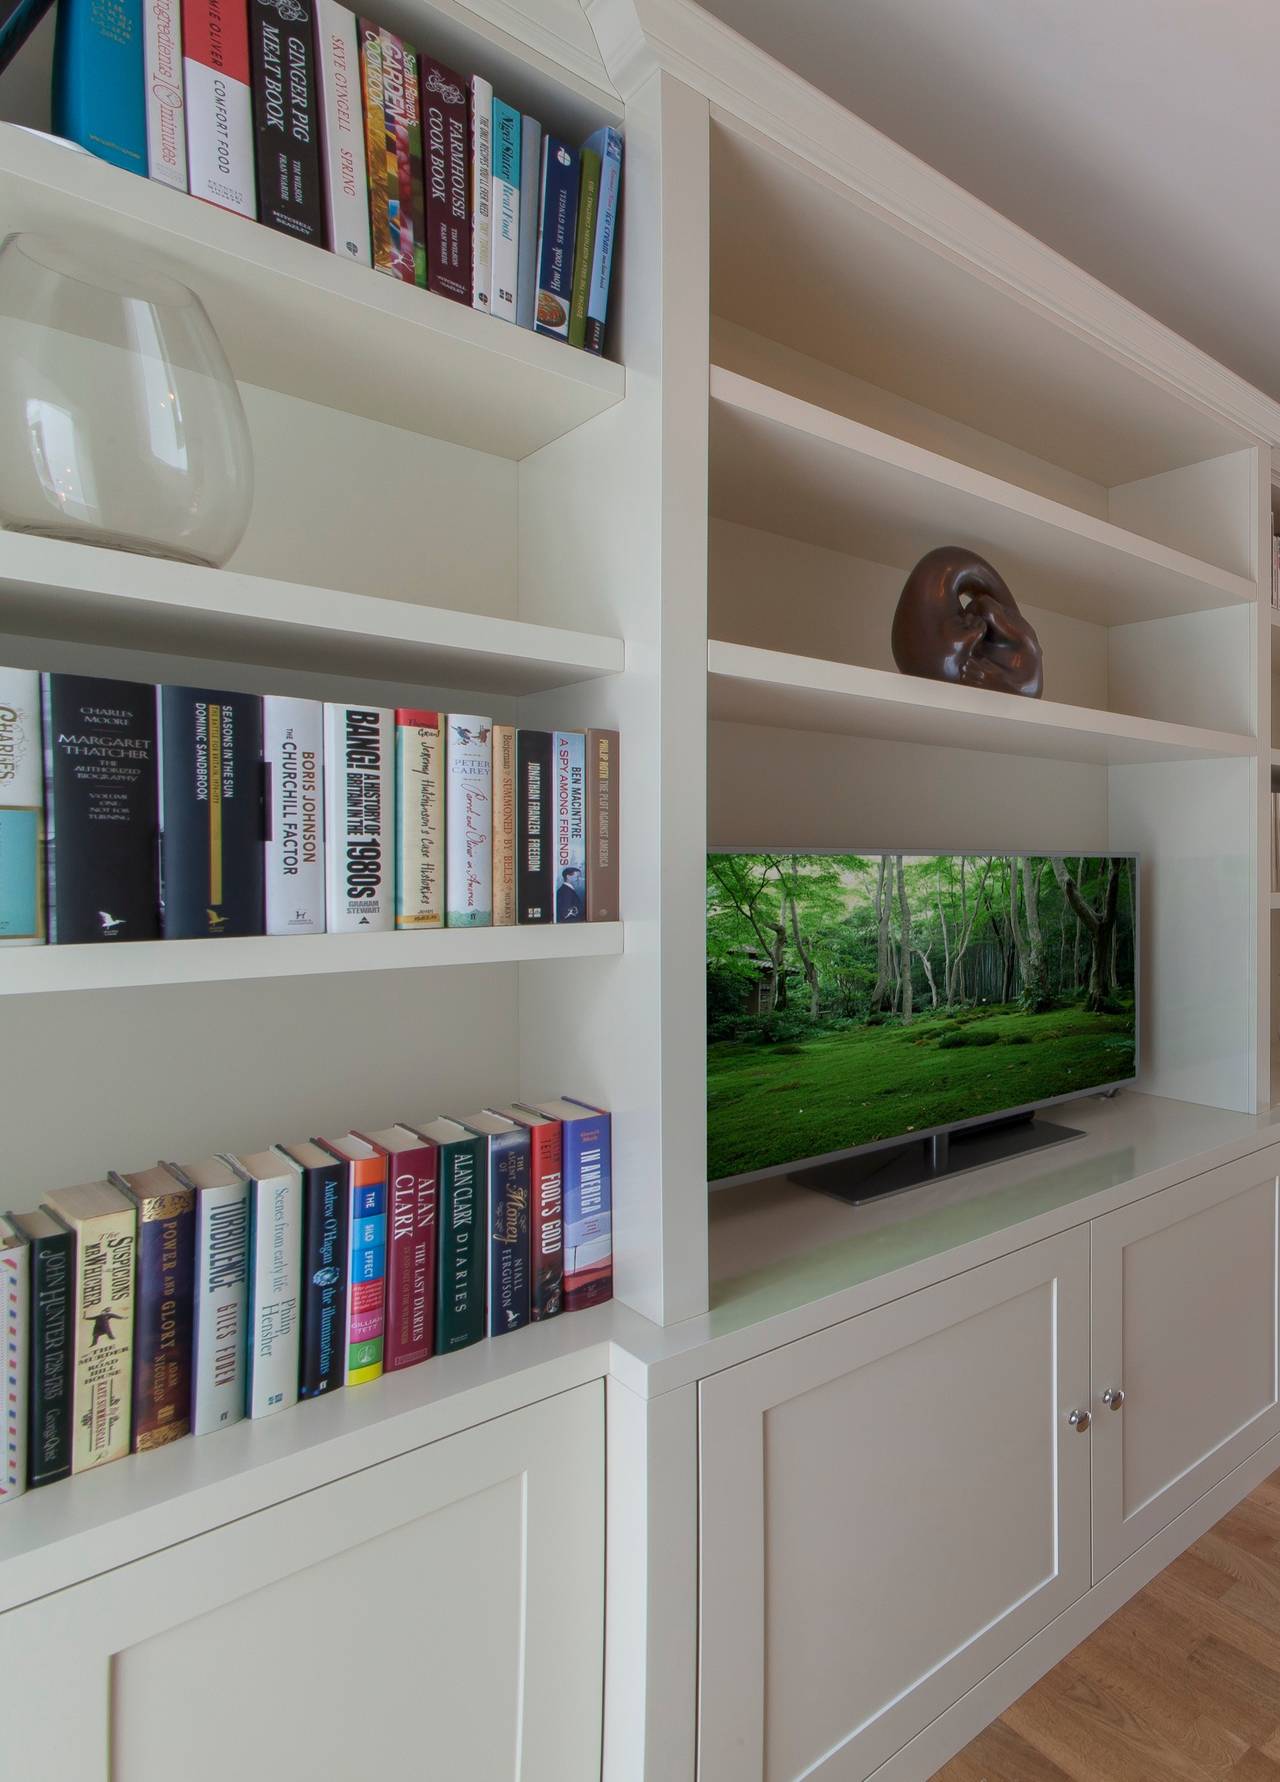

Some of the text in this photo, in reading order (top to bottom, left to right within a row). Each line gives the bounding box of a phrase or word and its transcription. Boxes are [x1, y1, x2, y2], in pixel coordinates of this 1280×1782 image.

[209, 22, 223, 67] OLIVER
[365, 30, 383, 110] COOKBOOK
[153, 73, 183, 108] 10
[263, 21, 284, 132] MEAT BOOK
[289, 37, 310, 143] GINGER PIG
[382, 45, 404, 119] GARDEN
[404, 50, 417, 127] Sarah Raven's
[160, 104, 177, 166] minutes
[214, 80, 230, 174] COMFORT FOOD
[332, 35, 356, 197] SKYE GYNGELL SPRING
[429, 107, 445, 202] COOK BOOK
[450, 118, 465, 220] FARMHOUSE
[499, 117, 513, 241] Nigel Slater Real Food
[279, 173, 288, 201] WARDE
[294, 174, 303, 204] WILSON
[551, 273, 560, 292] How
[57, 734, 150, 750] MARGARET
[80, 707, 134, 718] CHARLES
[84, 716, 130, 726] MOORE
[345, 710, 381, 771] BANG!
[62, 745, 150, 760] THATCHER
[74, 765, 142, 775] AUTHORIZED
[77, 773, 137, 783] BIOGRAPHY
[196, 703, 208, 801] DOMINIC SANDBROOK
[223, 705, 234, 798] SEASONS IN THE SUN
[282, 742, 298, 817] CHURCHILL
[452, 767, 490, 776] CAREY
[454, 760, 490, 769] PETER
[302, 751, 316, 863] BORIS JOHNSON
[347, 773, 364, 836] BRITAIN IN THE
[364, 782, 380, 822] HISTORY
[364, 825, 380, 836] OF
[421, 780, 435, 835] Hutchinson's
[466, 815, 477, 830] and
[503, 778, 513, 838] SUMMONED
[528, 762, 541, 872] JONATHAN FRANZEN FREEDOM
[572, 767, 582, 839] BEN MACINTYRE
[283, 823, 298, 875] FACTOR
[421, 839, 434, 858] Case
[503, 839, 513, 850] BY
[503, 856, 513, 885] BELLS
[454, 1153, 472, 1188] ALAN
[580, 1149, 601, 1163] IN
[395, 1174, 414, 1240] CLARK
[418, 1178, 435, 1228] ALAN
[453, 1188, 472, 1229] CLARK
[493, 1182, 527, 1244] Money
[541, 1172, 561, 1255] FOOL'S GOLD
[580, 1165, 601, 1214] AMERICA
[272, 1187, 289, 1293] Scenes from early life
[320, 1180, 339, 1264] Andrew O'Hagan
[364, 1192, 376, 1278] THE SILO EFFECT
[83, 1252, 107, 1309] WHICHER
[108, 1236, 133, 1301] SUSPICIONS
[161, 1221, 177, 1349] POWER AND GLORY
[209, 1197, 247, 1387] TURBULENCE GILES FODEN
[413, 1241, 425, 1341] THE LAST DIARIES
[455, 1232, 468, 1312] DIARIES
[502, 1249, 513, 1308] FERGUSON
[514, 1258, 523, 1291] NIALL
[40, 1250, 66, 1352] JOHN HUNTER
[260, 1303, 280, 1358] Hensher
[278, 1298, 297, 1342] Philip
[320, 1287, 335, 1376] the illuminations
[168, 1361, 178, 1388] ADAM
